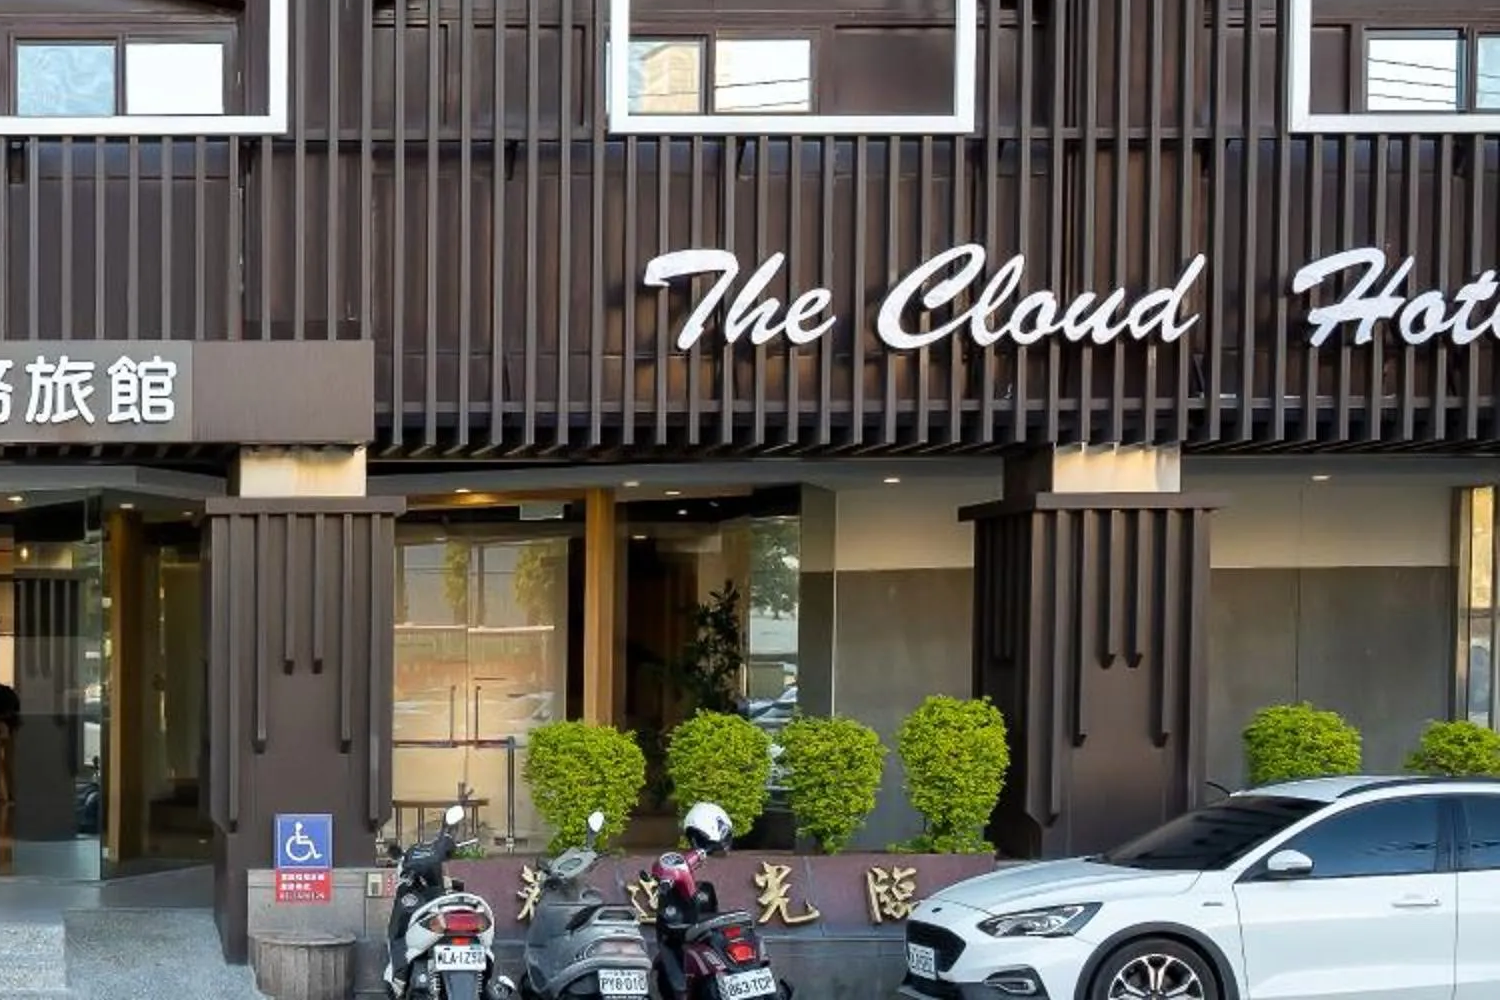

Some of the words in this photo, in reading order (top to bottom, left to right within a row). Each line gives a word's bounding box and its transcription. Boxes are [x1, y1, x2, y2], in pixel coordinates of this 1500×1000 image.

[644, 249, 835, 352] The
[877, 242, 1205, 350] Cloud
[1293, 247, 1500, 347] Hot
